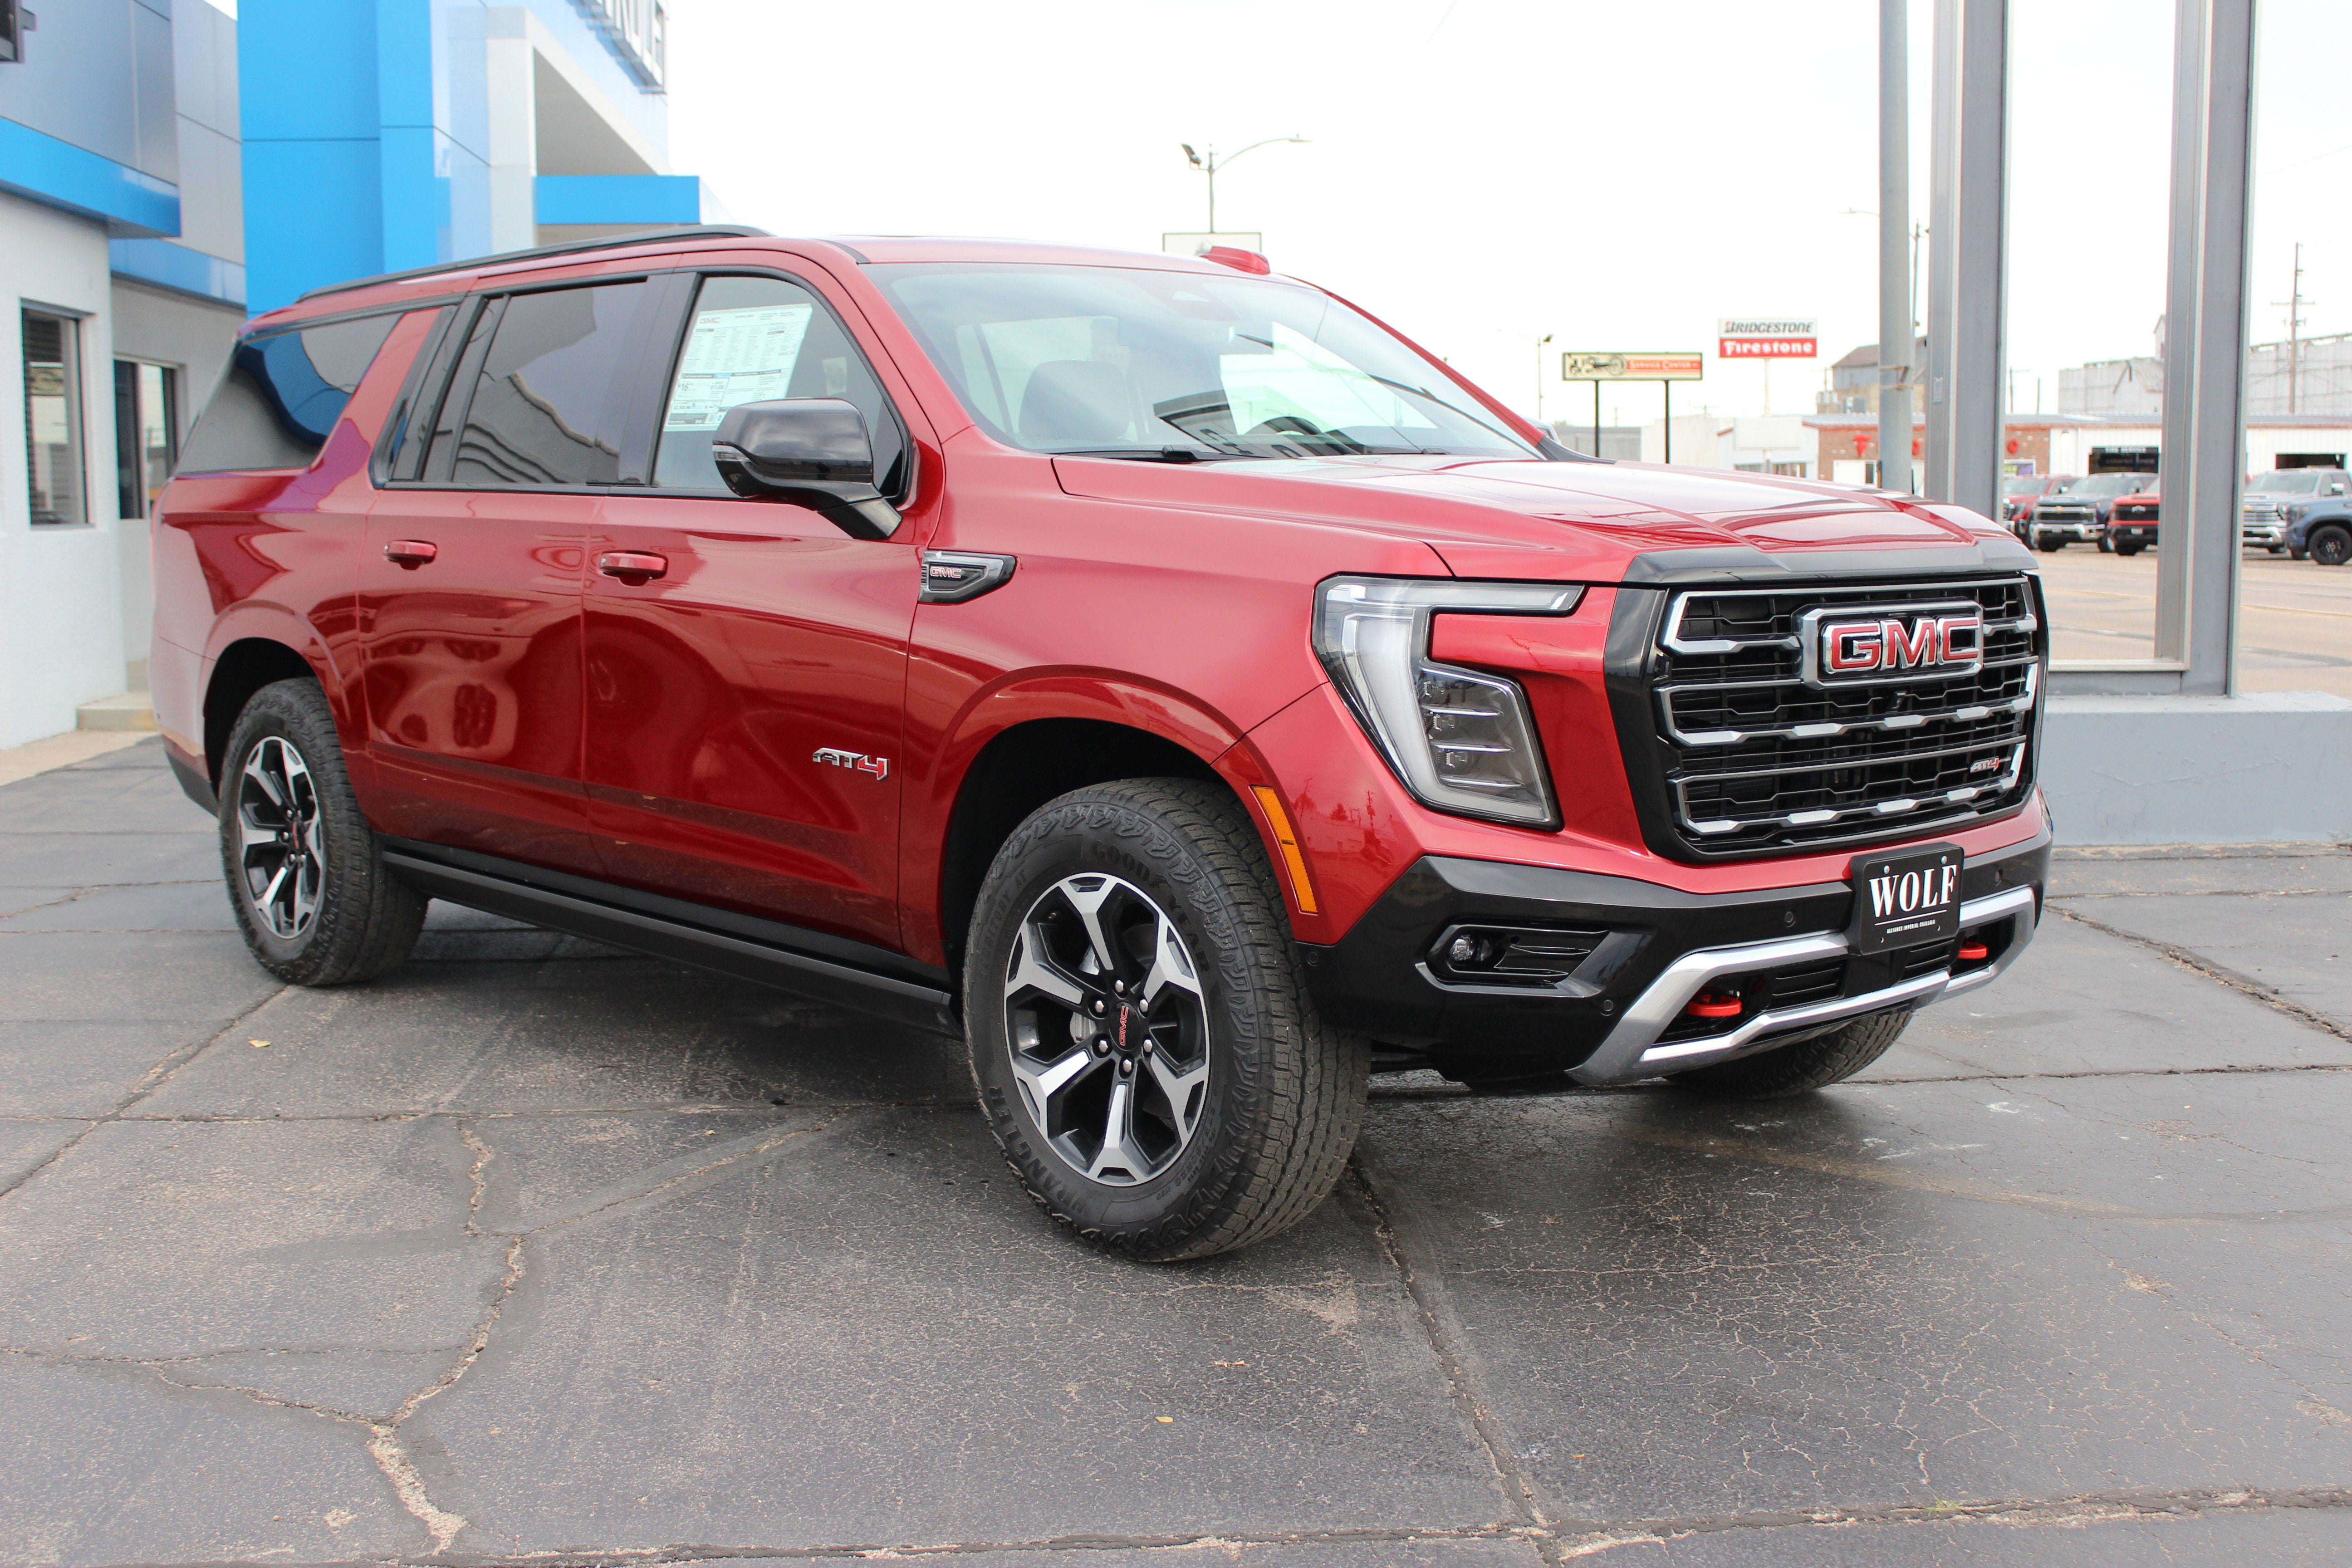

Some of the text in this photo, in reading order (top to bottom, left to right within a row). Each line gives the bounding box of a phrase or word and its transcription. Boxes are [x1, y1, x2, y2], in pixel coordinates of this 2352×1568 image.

[1724, 321, 1814, 333] BRIDGESTONE
[1724, 340, 1813, 357] Firestone
[930, 566, 962, 578] GMC
[1823, 617, 1980, 674] GMC
[813, 747, 888, 780] AT4
[1970, 756, 2000, 773] AT4
[1868, 864, 1957, 918] WOLF
[1886, 926, 1903, 934] ALLIANCE
[1119, 1005, 1129, 1046] GMC
[988, 1085, 1091, 1217] WRANGLER
